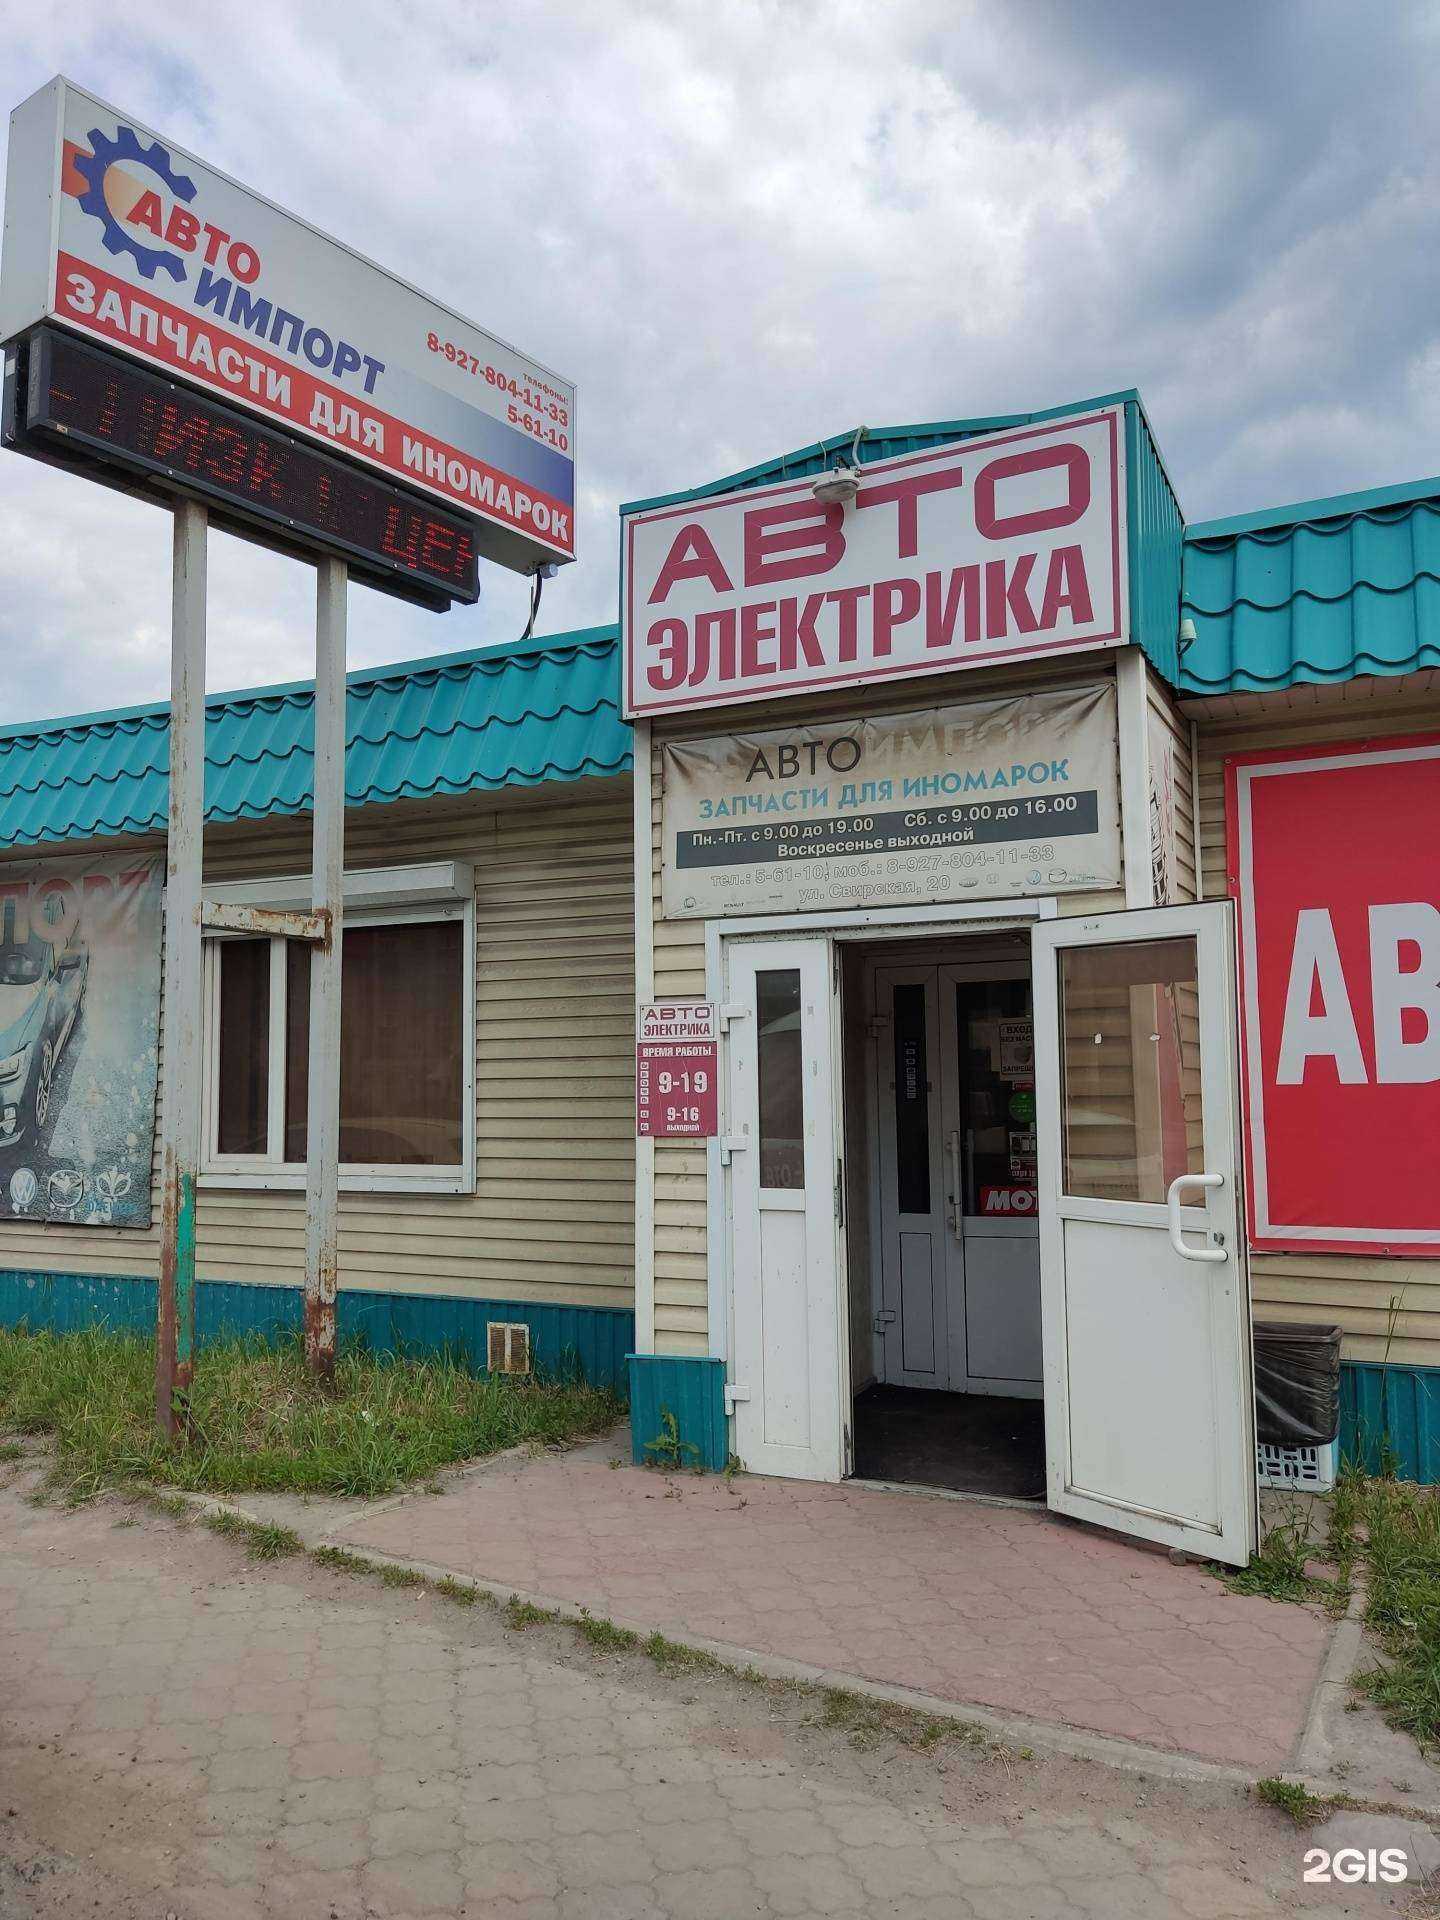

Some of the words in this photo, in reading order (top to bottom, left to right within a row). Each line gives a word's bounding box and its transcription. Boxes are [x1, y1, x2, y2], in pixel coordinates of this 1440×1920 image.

[126, 190, 261, 285] АВТО
[194, 267, 385, 395] ИМПОРТ
[427, 332, 568, 427] 8-927-804-11-33
[65, 273, 292, 409] ЗАПЧАСТИ
[309, 389, 385, 454] ДЛЯ
[402, 428, 570, 543] ИНОМАРОК
[507, 404, 568, 451] 5-61-10
[647, 442, 1091, 606] АВТО
[646, 544, 1095, 692] ЭЛЕКТРИКА
[698, 787, 829, 819] ЗАПЧАСТИ
[837, 780, 893, 810] ДЛЯ
[903, 758, 1070, 799] ИНОМАРОК
[692, 830, 748, 847] Пн.-Пт.
[751, 831, 760, 841] с
[764, 824, 799, 840] 9.00
[802, 823, 823, 839] до
[827, 817, 874, 835] 19.00
[904, 811, 932, 828] Сб.
[937, 813, 948, 824] с
[951, 805, 992, 823] 9.00
[995, 805, 1019, 820] до
[1024, 796, 1078, 816] 16.00
[777, 836, 884, 857] Воскресенье
[887, 827, 974, 848] выходной
[710, 872, 751, 888] тел.:
[833, 859, 882, 878] моб.:
[886, 845, 1055, 875] 8-927-804-11-33
[798, 887, 824, 904] ул.
[828, 879, 922, 899] Свирская,
[926, 875, 951, 891] 20
[644, 1022, 710, 1037] ЭЛЕКТРИКА
[645, 1007, 710, 1020] АВТО
[642, 1047, 674, 1057] ВРЕМЯ
[675, 1046, 712, 1056] РАБОТЫ
[658, 1071, 708, 1093] 9-19
[667, 1107, 699, 1122] 9-16
